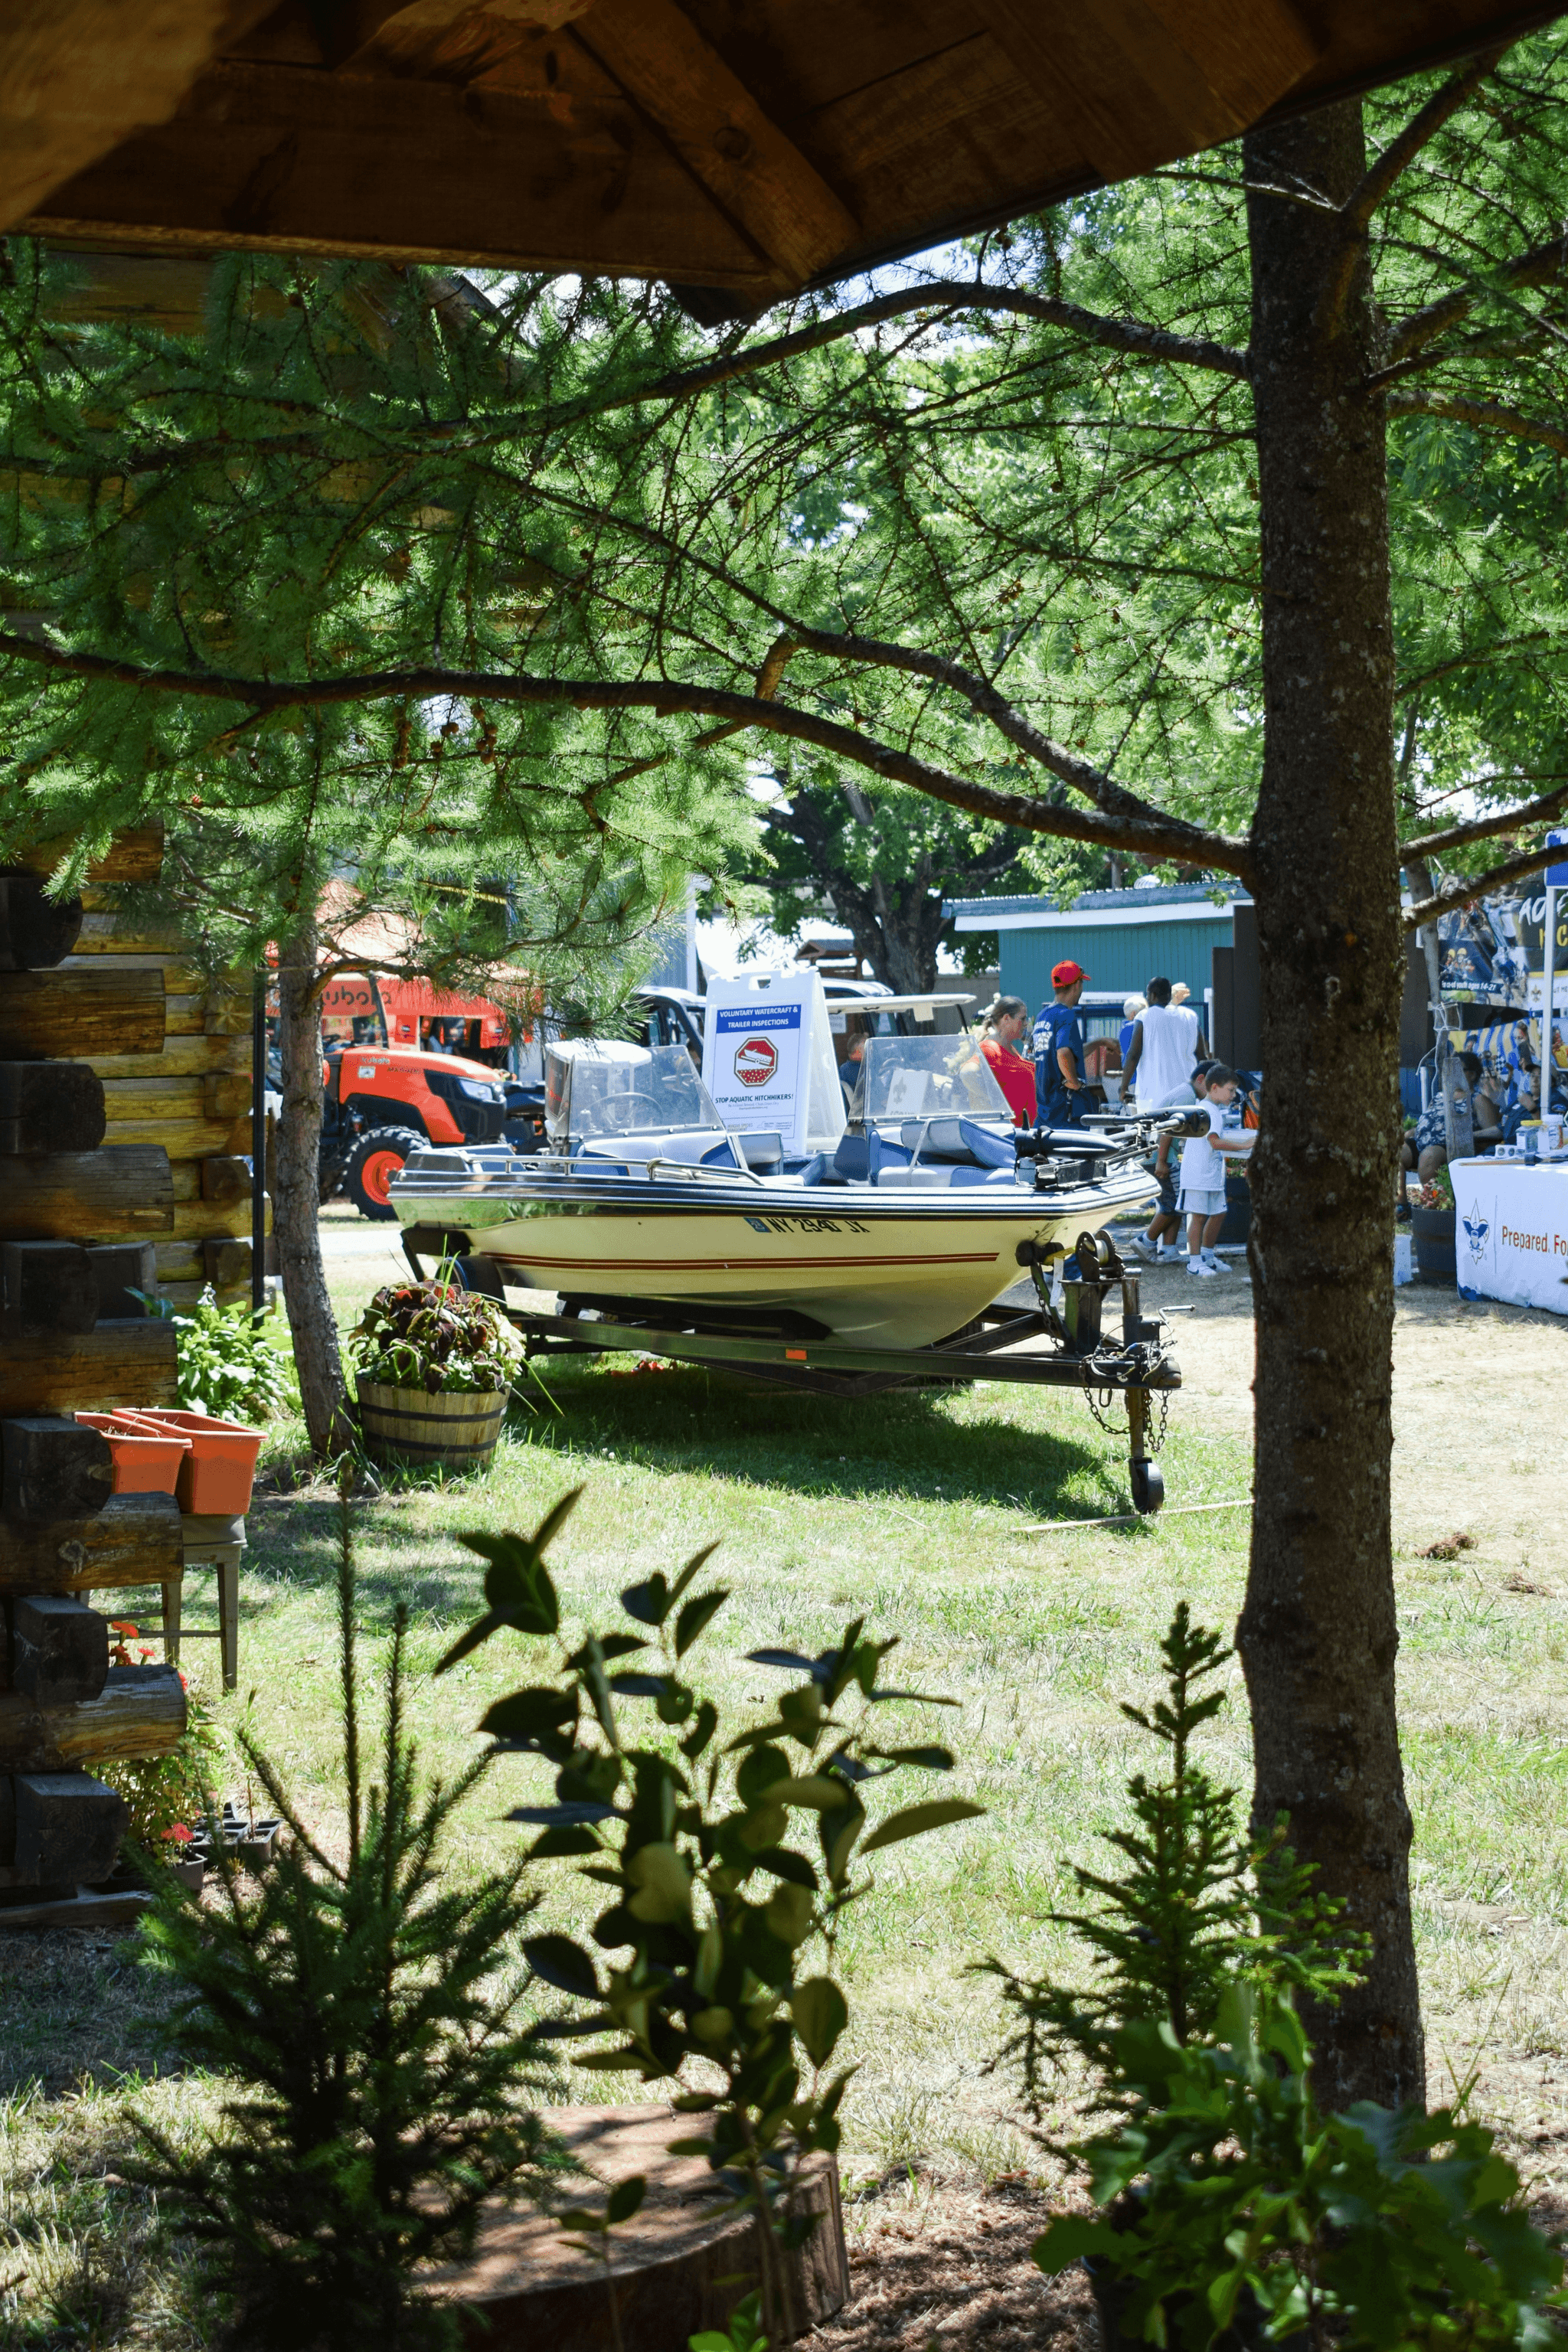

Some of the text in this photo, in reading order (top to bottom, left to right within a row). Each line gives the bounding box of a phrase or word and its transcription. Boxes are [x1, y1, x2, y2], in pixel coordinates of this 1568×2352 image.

[720, 1008, 753, 1018] VOLUNTARY
[754, 1006, 792, 1015] WATERCRAFT
[751, 1018, 789, 1027] INSPECTIONS
[765, 1217, 795, 1233] NY
[844, 1220, 871, 1233] JX
[1502, 1225, 1568, 1256] Prepared. Fo
